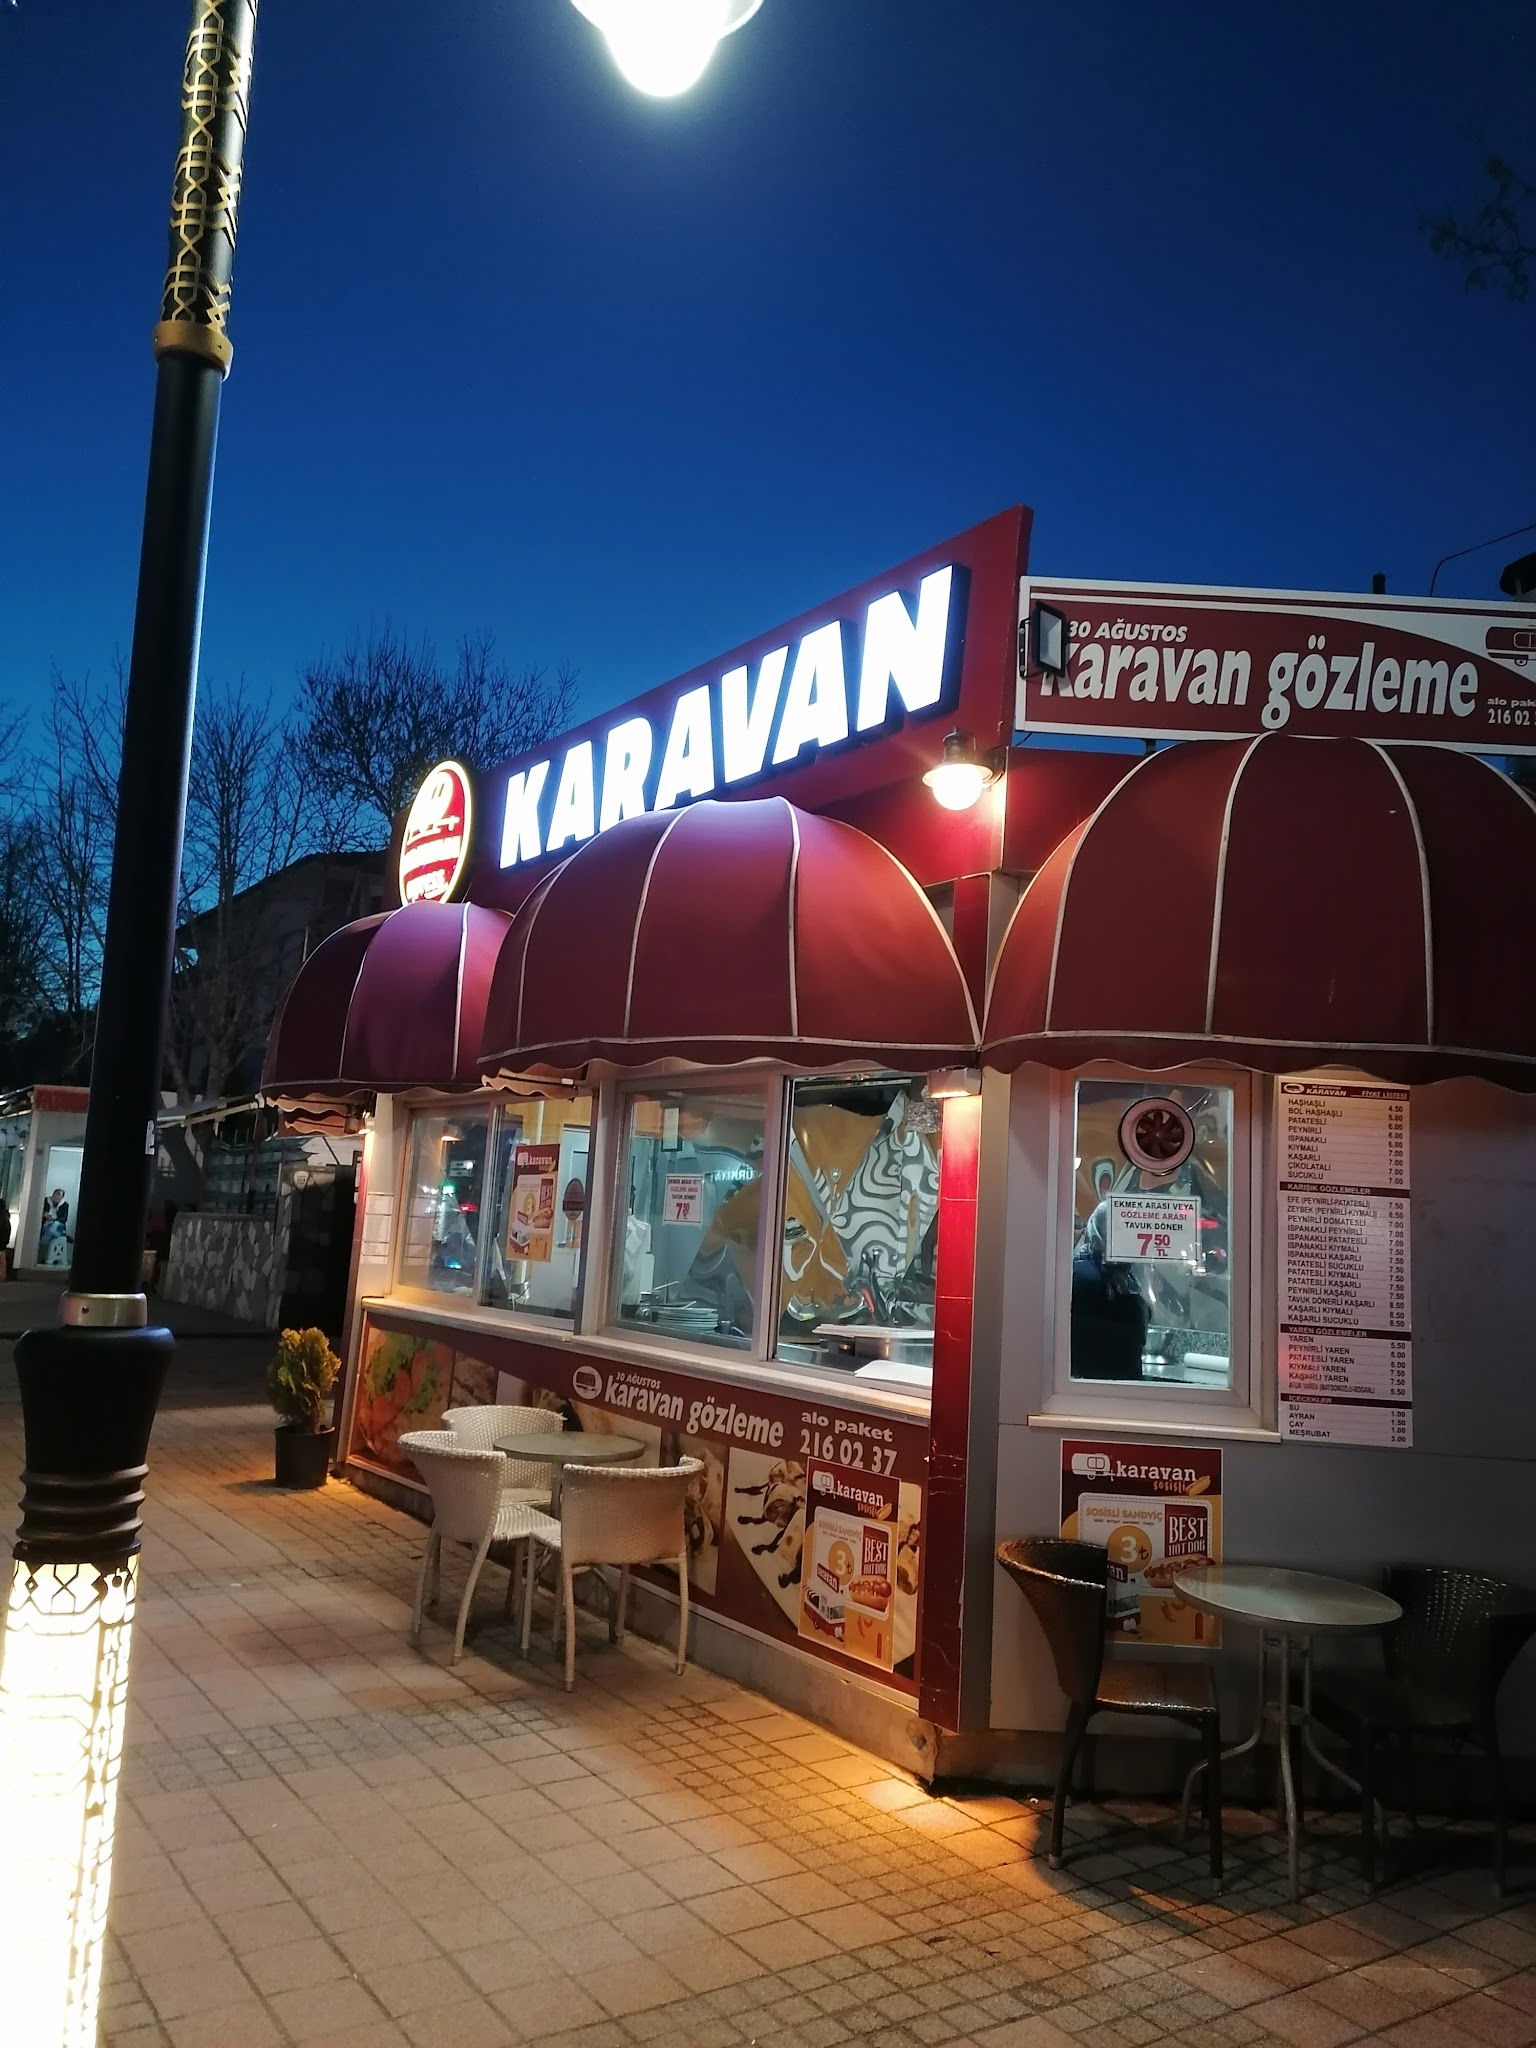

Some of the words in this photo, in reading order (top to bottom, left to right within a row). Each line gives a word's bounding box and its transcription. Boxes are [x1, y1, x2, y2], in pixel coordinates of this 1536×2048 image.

[1069, 621, 1091, 637] 30
[1094, 618, 1188, 643] AĞUSTOS
[1260, 634, 1479, 730] gözleme
[1487, 697, 1508, 706] alo
[500, 565, 953, 869] KARAVAN
[1487, 708, 1511, 725] 216
[1514, 710, 1531, 726] 02
[1306, 1088, 1347, 1097] KARAVAN
[1288, 1099, 1326, 1108] HAŞHAŞLI
[1305, 1109, 1343, 1118] HAŞHAŞLI
[1288, 1117, 1327, 1125] PATATESLİ
[1288, 1126, 1322, 1134] PEYNİRLİ
[1288, 1171, 1324, 1179] SUCUKLU
[1114, 1201, 1143, 1209] EKMEK
[1121, 1211, 1160, 1219] GÖZLEME
[1287, 1215, 1322, 1224] PEYNİRLİ
[1154, 1223, 1183, 1231] DÖNER
[1137, 1233, 1153, 1256] 7
[1154, 1234, 1171, 1246] 50
[1157, 1249, 1168, 1257] TL
[1322, 1317, 1359, 1326] SUCUKLU
[1288, 1335, 1315, 1343] YAREN
[1324, 1347, 1350, 1355] YAREN
[1329, 1356, 1355, 1365] YAREN
[1321, 1365, 1347, 1373] YAREN
[616, 1372, 625, 1381] 30
[626, 1373, 661, 1389] AĞUSTOS
[1323, 1374, 1349, 1383] YAREN
[604, 1375, 684, 1421] karavan
[686, 1395, 784, 1448] gözleme
[801, 1412, 829, 1427] alo
[834, 1419, 893, 1443] paket
[1289, 1429, 1332, 1438] MEŞRUBAT
[800, 1429, 834, 1461] 216
[839, 1438, 864, 1469] 02
[871, 1446, 898, 1476] 37
[1116, 1460, 1197, 1482] karavan
[837, 1480, 884, 1507] karavan
[1086, 1506, 1120, 1518] SOSİSLİ
[1169, 1515, 1207, 1544] BEST
[864, 1537, 889, 1563] BEST
[1121, 1535, 1138, 1563] 3
[1168, 1541, 1187, 1557] HOT
[1187, 1538, 1206, 1554] DOG
[836, 1550, 847, 1576] 3
